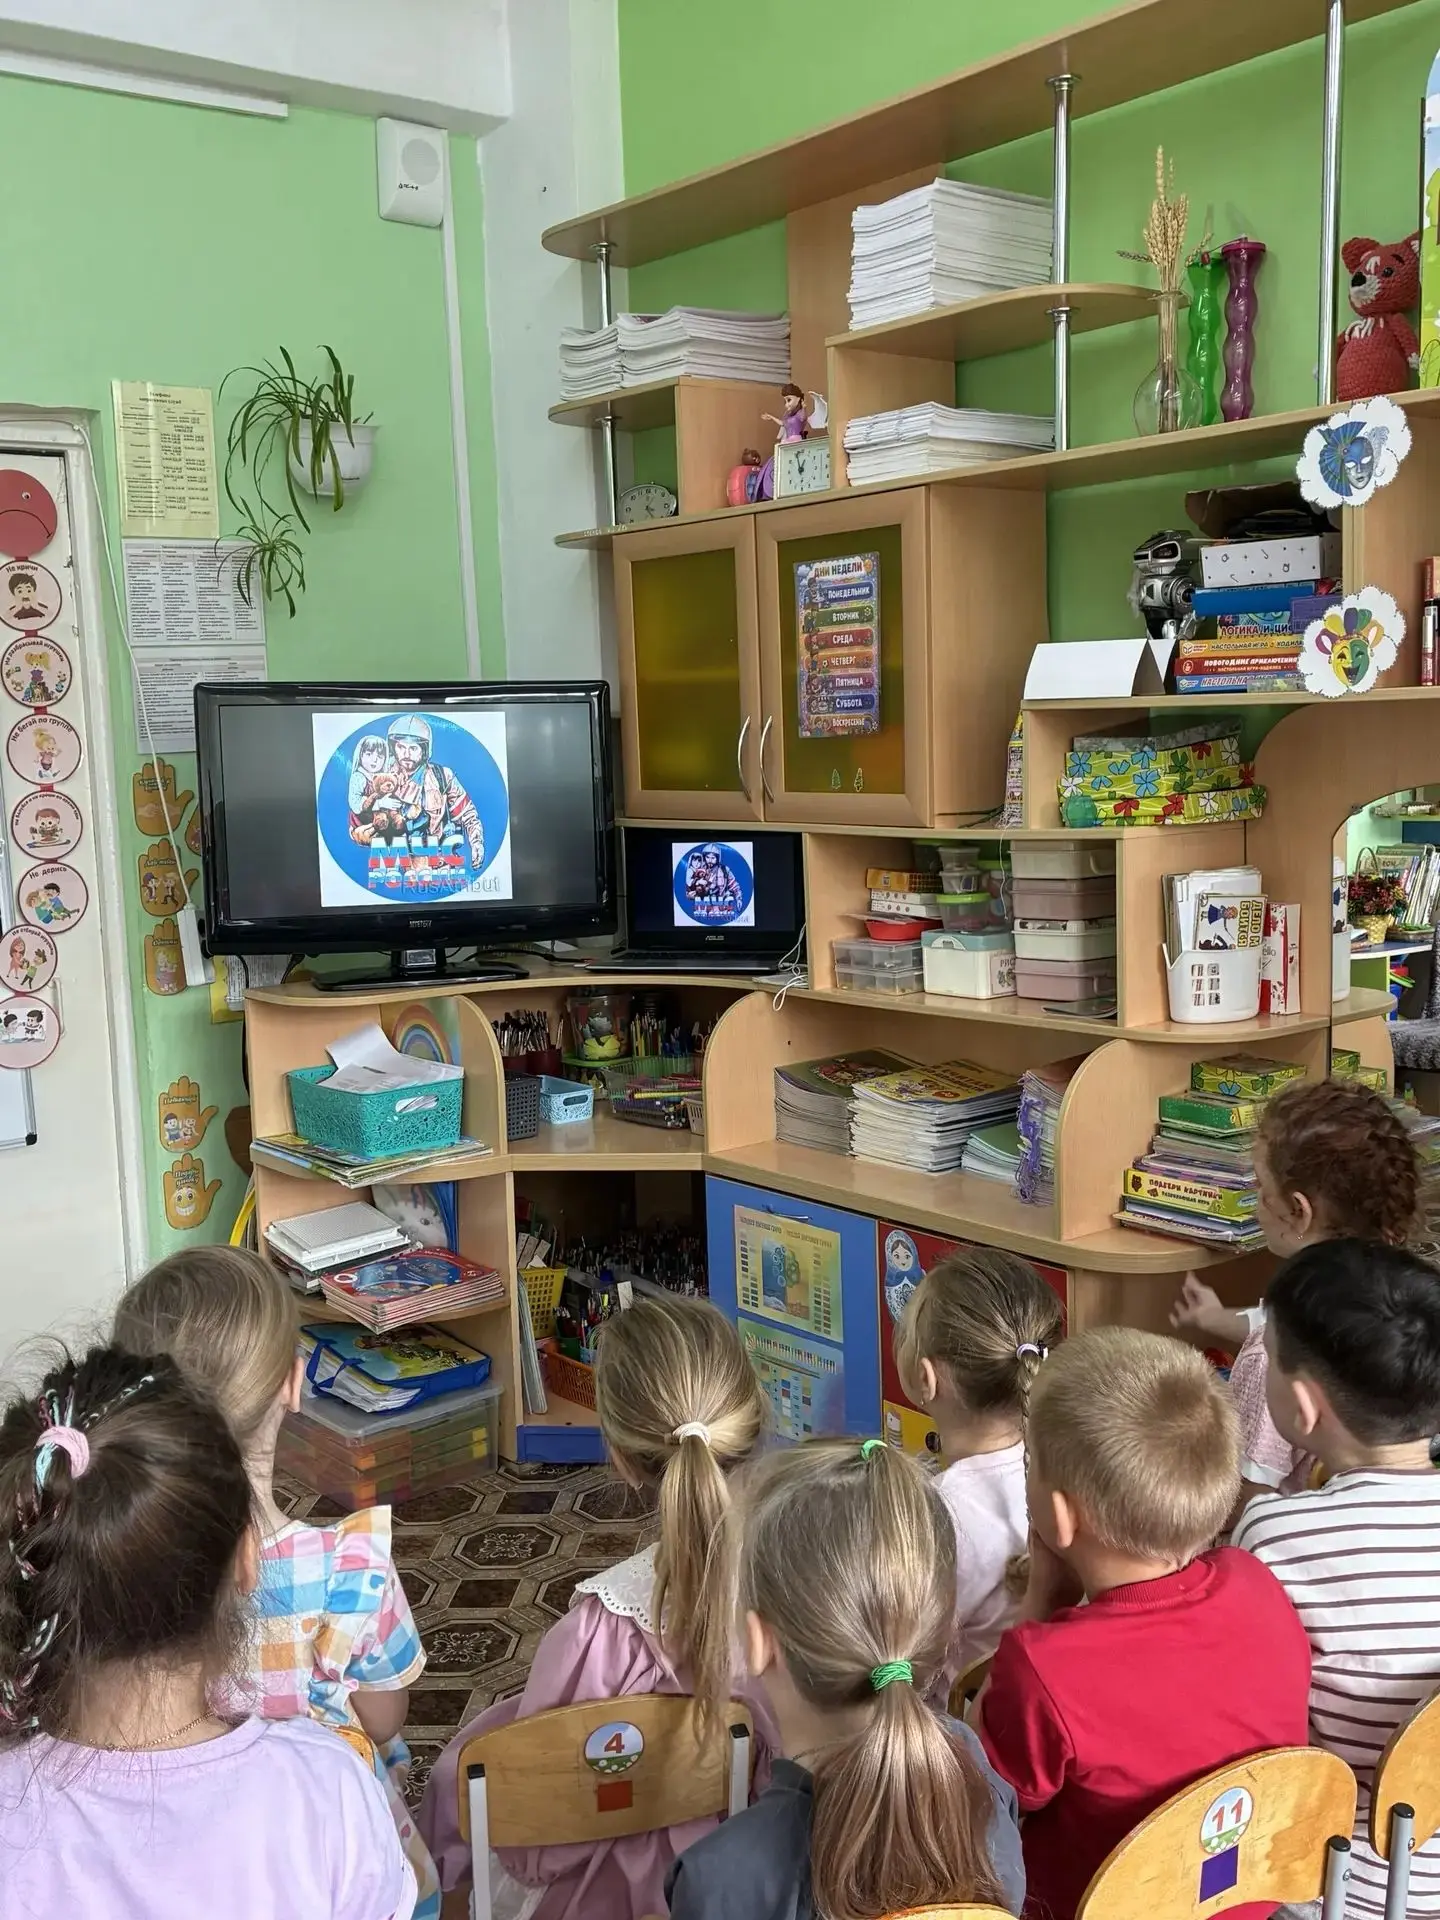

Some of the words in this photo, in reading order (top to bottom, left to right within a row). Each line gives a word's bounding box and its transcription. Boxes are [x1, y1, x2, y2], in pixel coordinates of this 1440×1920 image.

[814, 565, 830, 578] ДНИ
[831, 561, 863, 575] НЕДЕЛИ
[828, 586, 870, 599] ПОНЕДЕЛЬНИК
[832, 611, 860, 622] ВТОРНИК
[1221, 624, 1258, 636] ЛОГИКА
[832, 634, 854, 644] СРЕДА
[1210, 642, 1253, 651] НАСТОЛЬНАЯ
[1252, 641, 1269, 650] ИГРА
[831, 655, 857, 666] ЧЕТВЕРГ
[1204, 657, 1249, 667] НОВОГОДНИЕ
[835, 677, 864, 687] ПЯТНИЦА
[835, 698, 863, 708] СУББОТА
[11, 731, 20, 742] Не
[17, 717, 38, 733] бегай
[48, 717, 73, 733] группе
[368, 834, 465, 869] МЧС
[29, 871, 40, 880] Не
[42, 866, 67, 877] дерись
[1237, 899, 1251, 948] БОИТСЯ
[1250, 899, 1263, 935] ДЕЛО
[1149, 1178, 1181, 1192] ПОДБЕРИ
[1183, 1185, 1223, 1200] КАРТИНКИ
[604, 1732, 625, 1754] 4
[1211, 1796, 1244, 1833] 11
